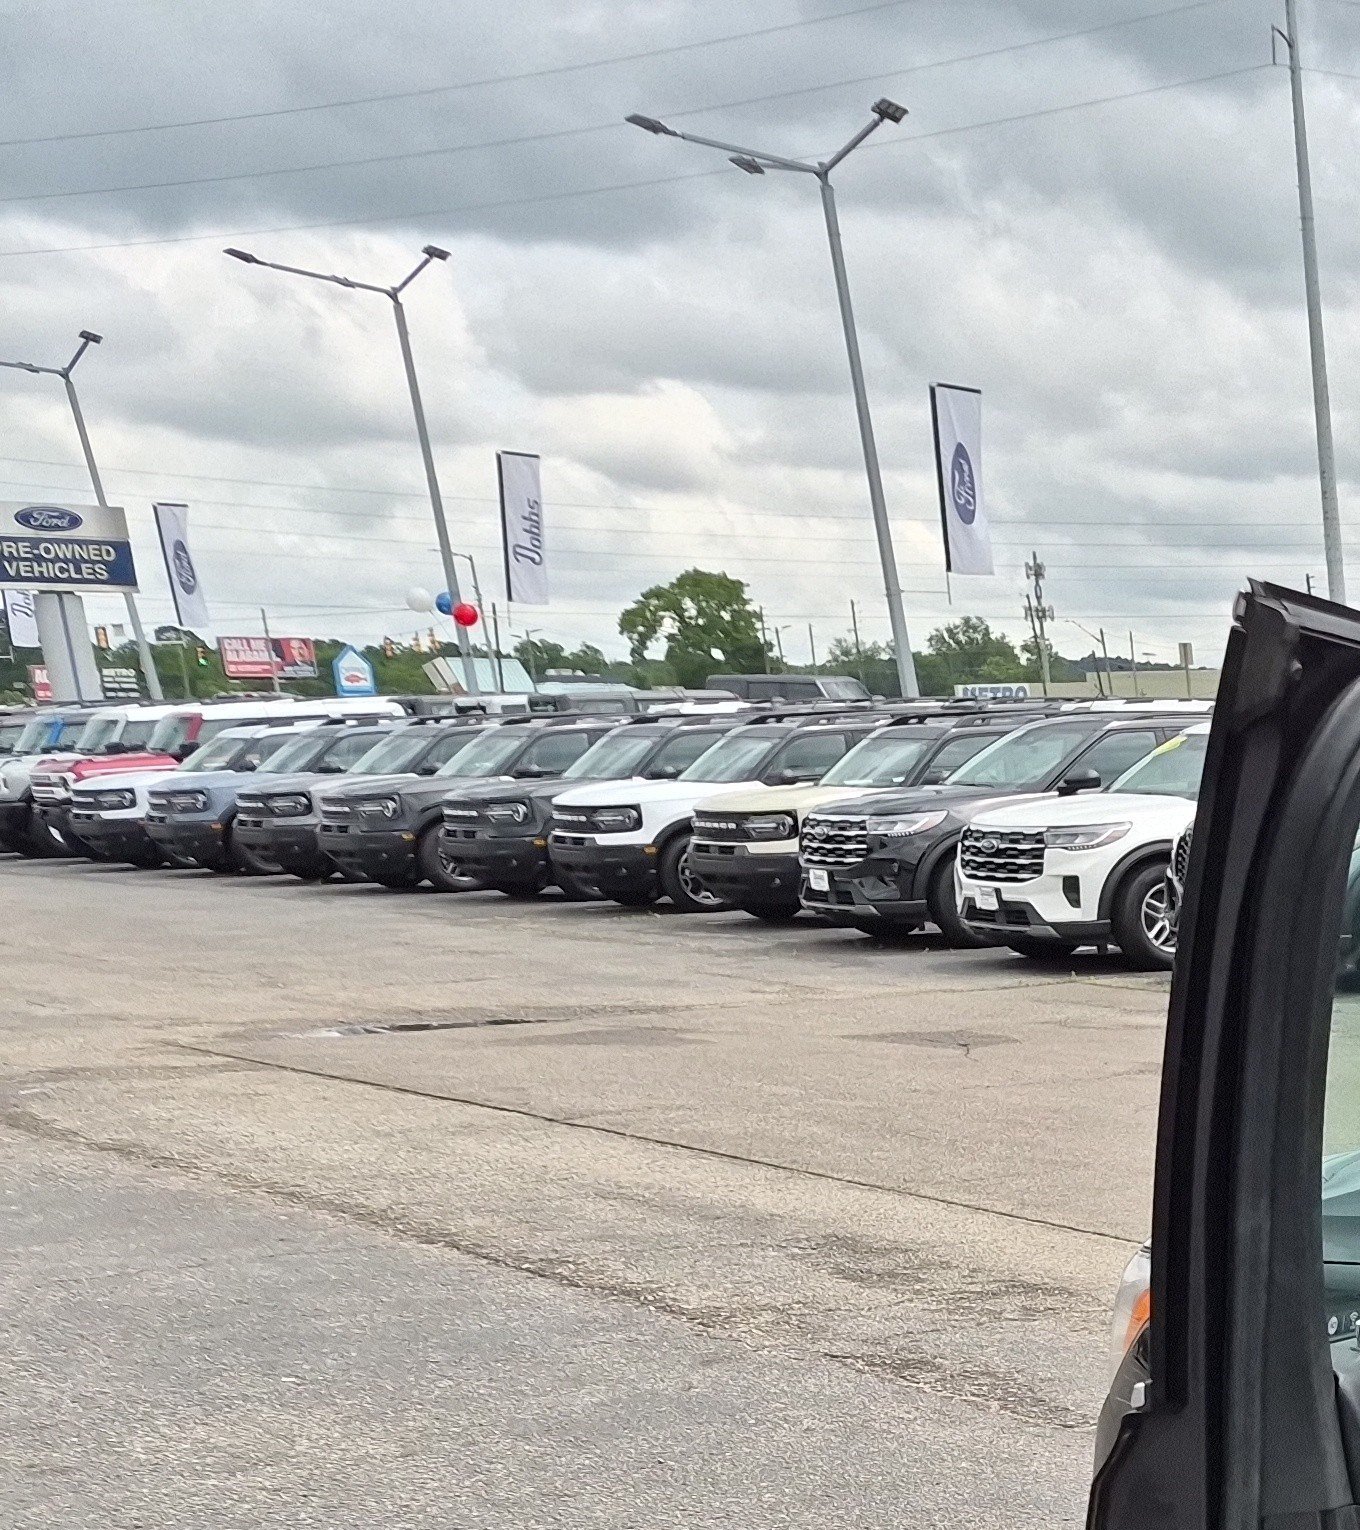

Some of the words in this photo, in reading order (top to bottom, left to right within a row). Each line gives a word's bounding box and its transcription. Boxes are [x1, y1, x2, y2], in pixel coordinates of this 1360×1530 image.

[954, 458, 975, 510] Ford
[512, 497, 543, 566] Dobbs
[0, 541, 117, 562] RE-OWNED
[4, 561, 110, 580] VEHICLES
[963, 686, 1027, 699] METRO
